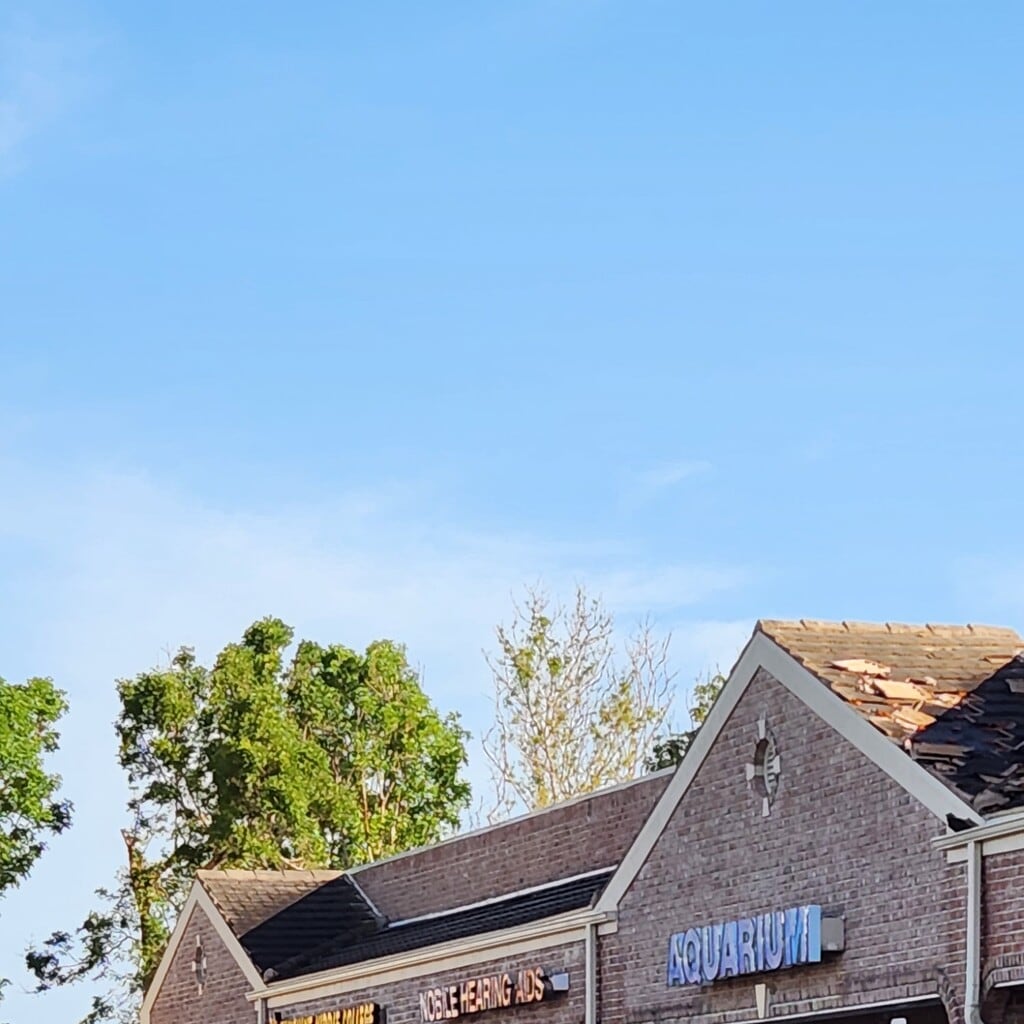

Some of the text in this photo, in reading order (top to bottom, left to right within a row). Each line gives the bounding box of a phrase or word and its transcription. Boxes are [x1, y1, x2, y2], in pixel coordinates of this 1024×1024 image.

[667, 905, 822, 987] AQUARIUM
[460, 974, 512, 1014] HEARING
[515, 967, 546, 1005] AIDS
